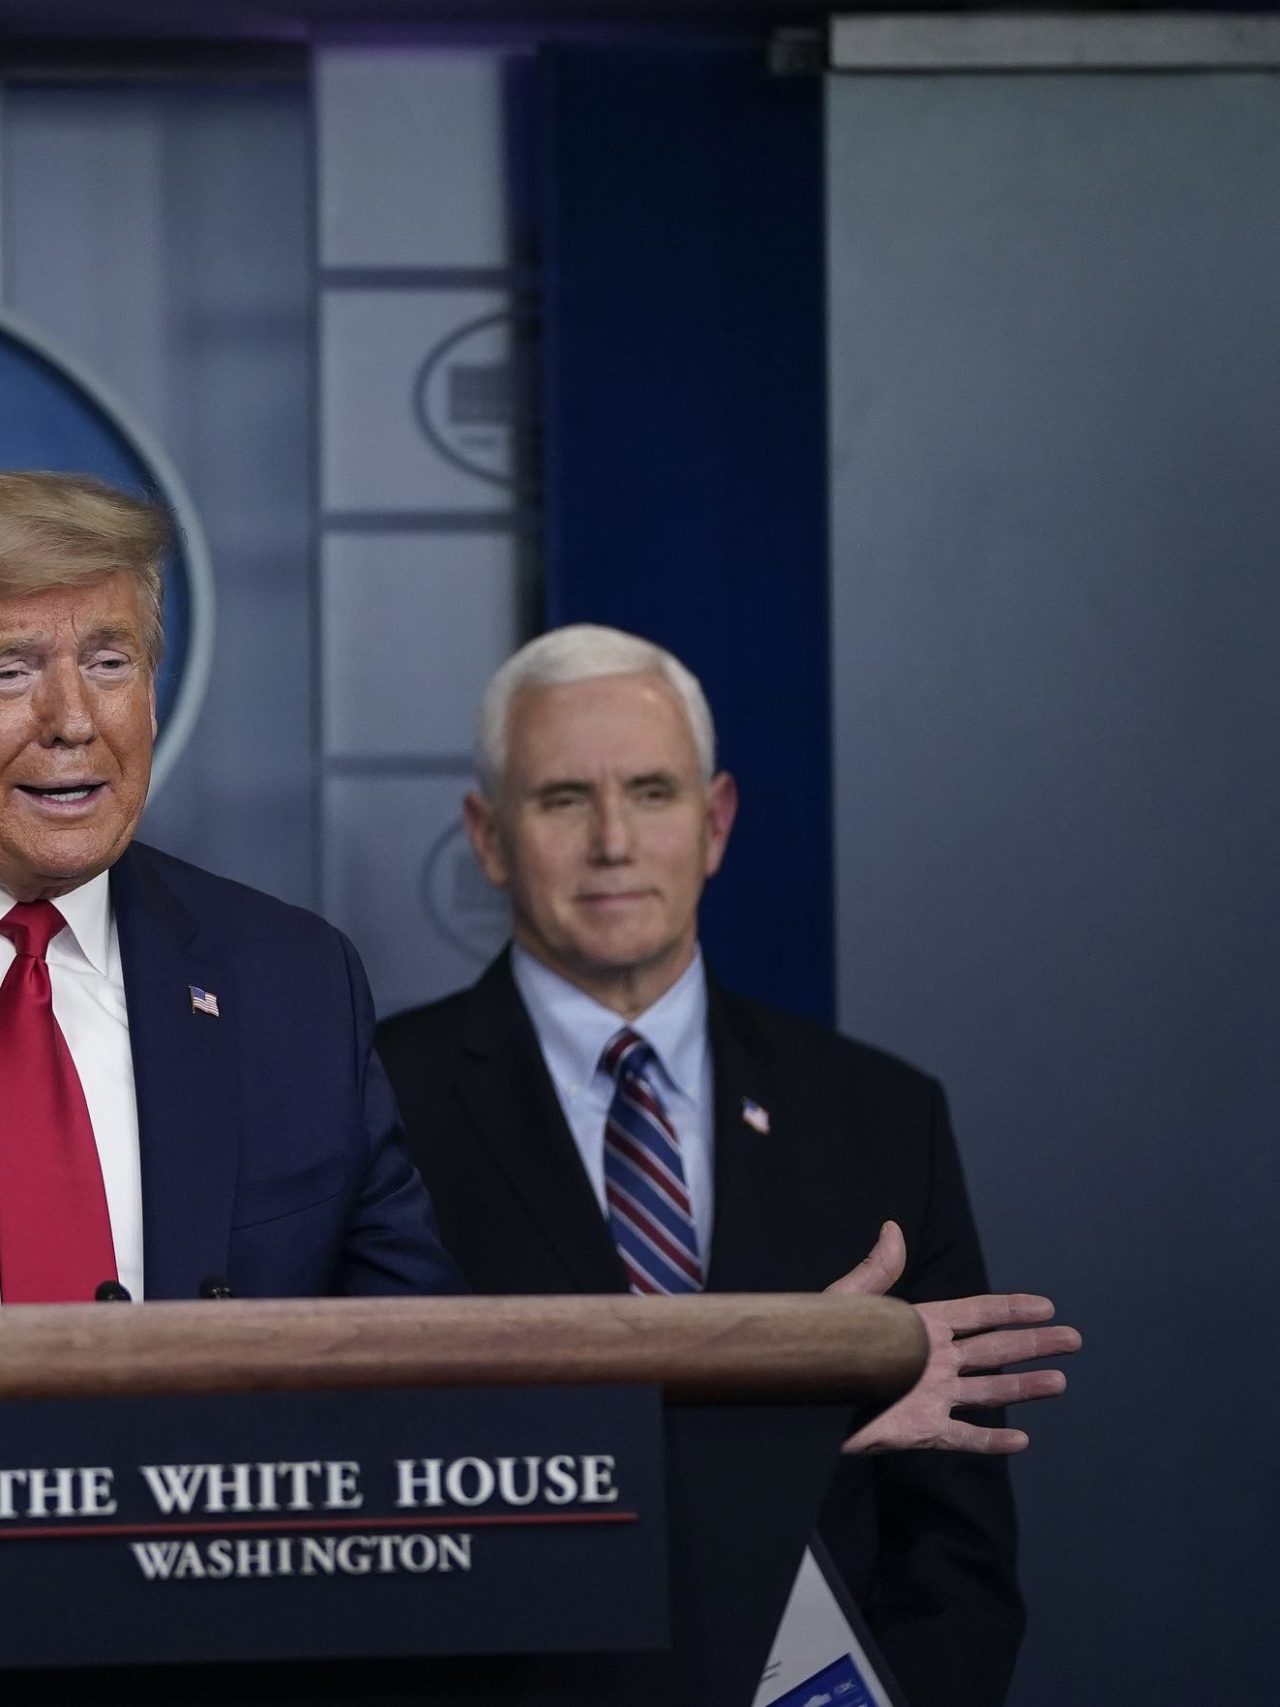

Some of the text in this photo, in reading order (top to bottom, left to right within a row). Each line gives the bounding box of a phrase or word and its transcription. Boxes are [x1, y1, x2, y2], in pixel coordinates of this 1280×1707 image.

[140, 1461, 363, 1513] WHITE
[396, 1455, 618, 1506] HOUSE
[131, 1534, 472, 1580] WASHINGTON
